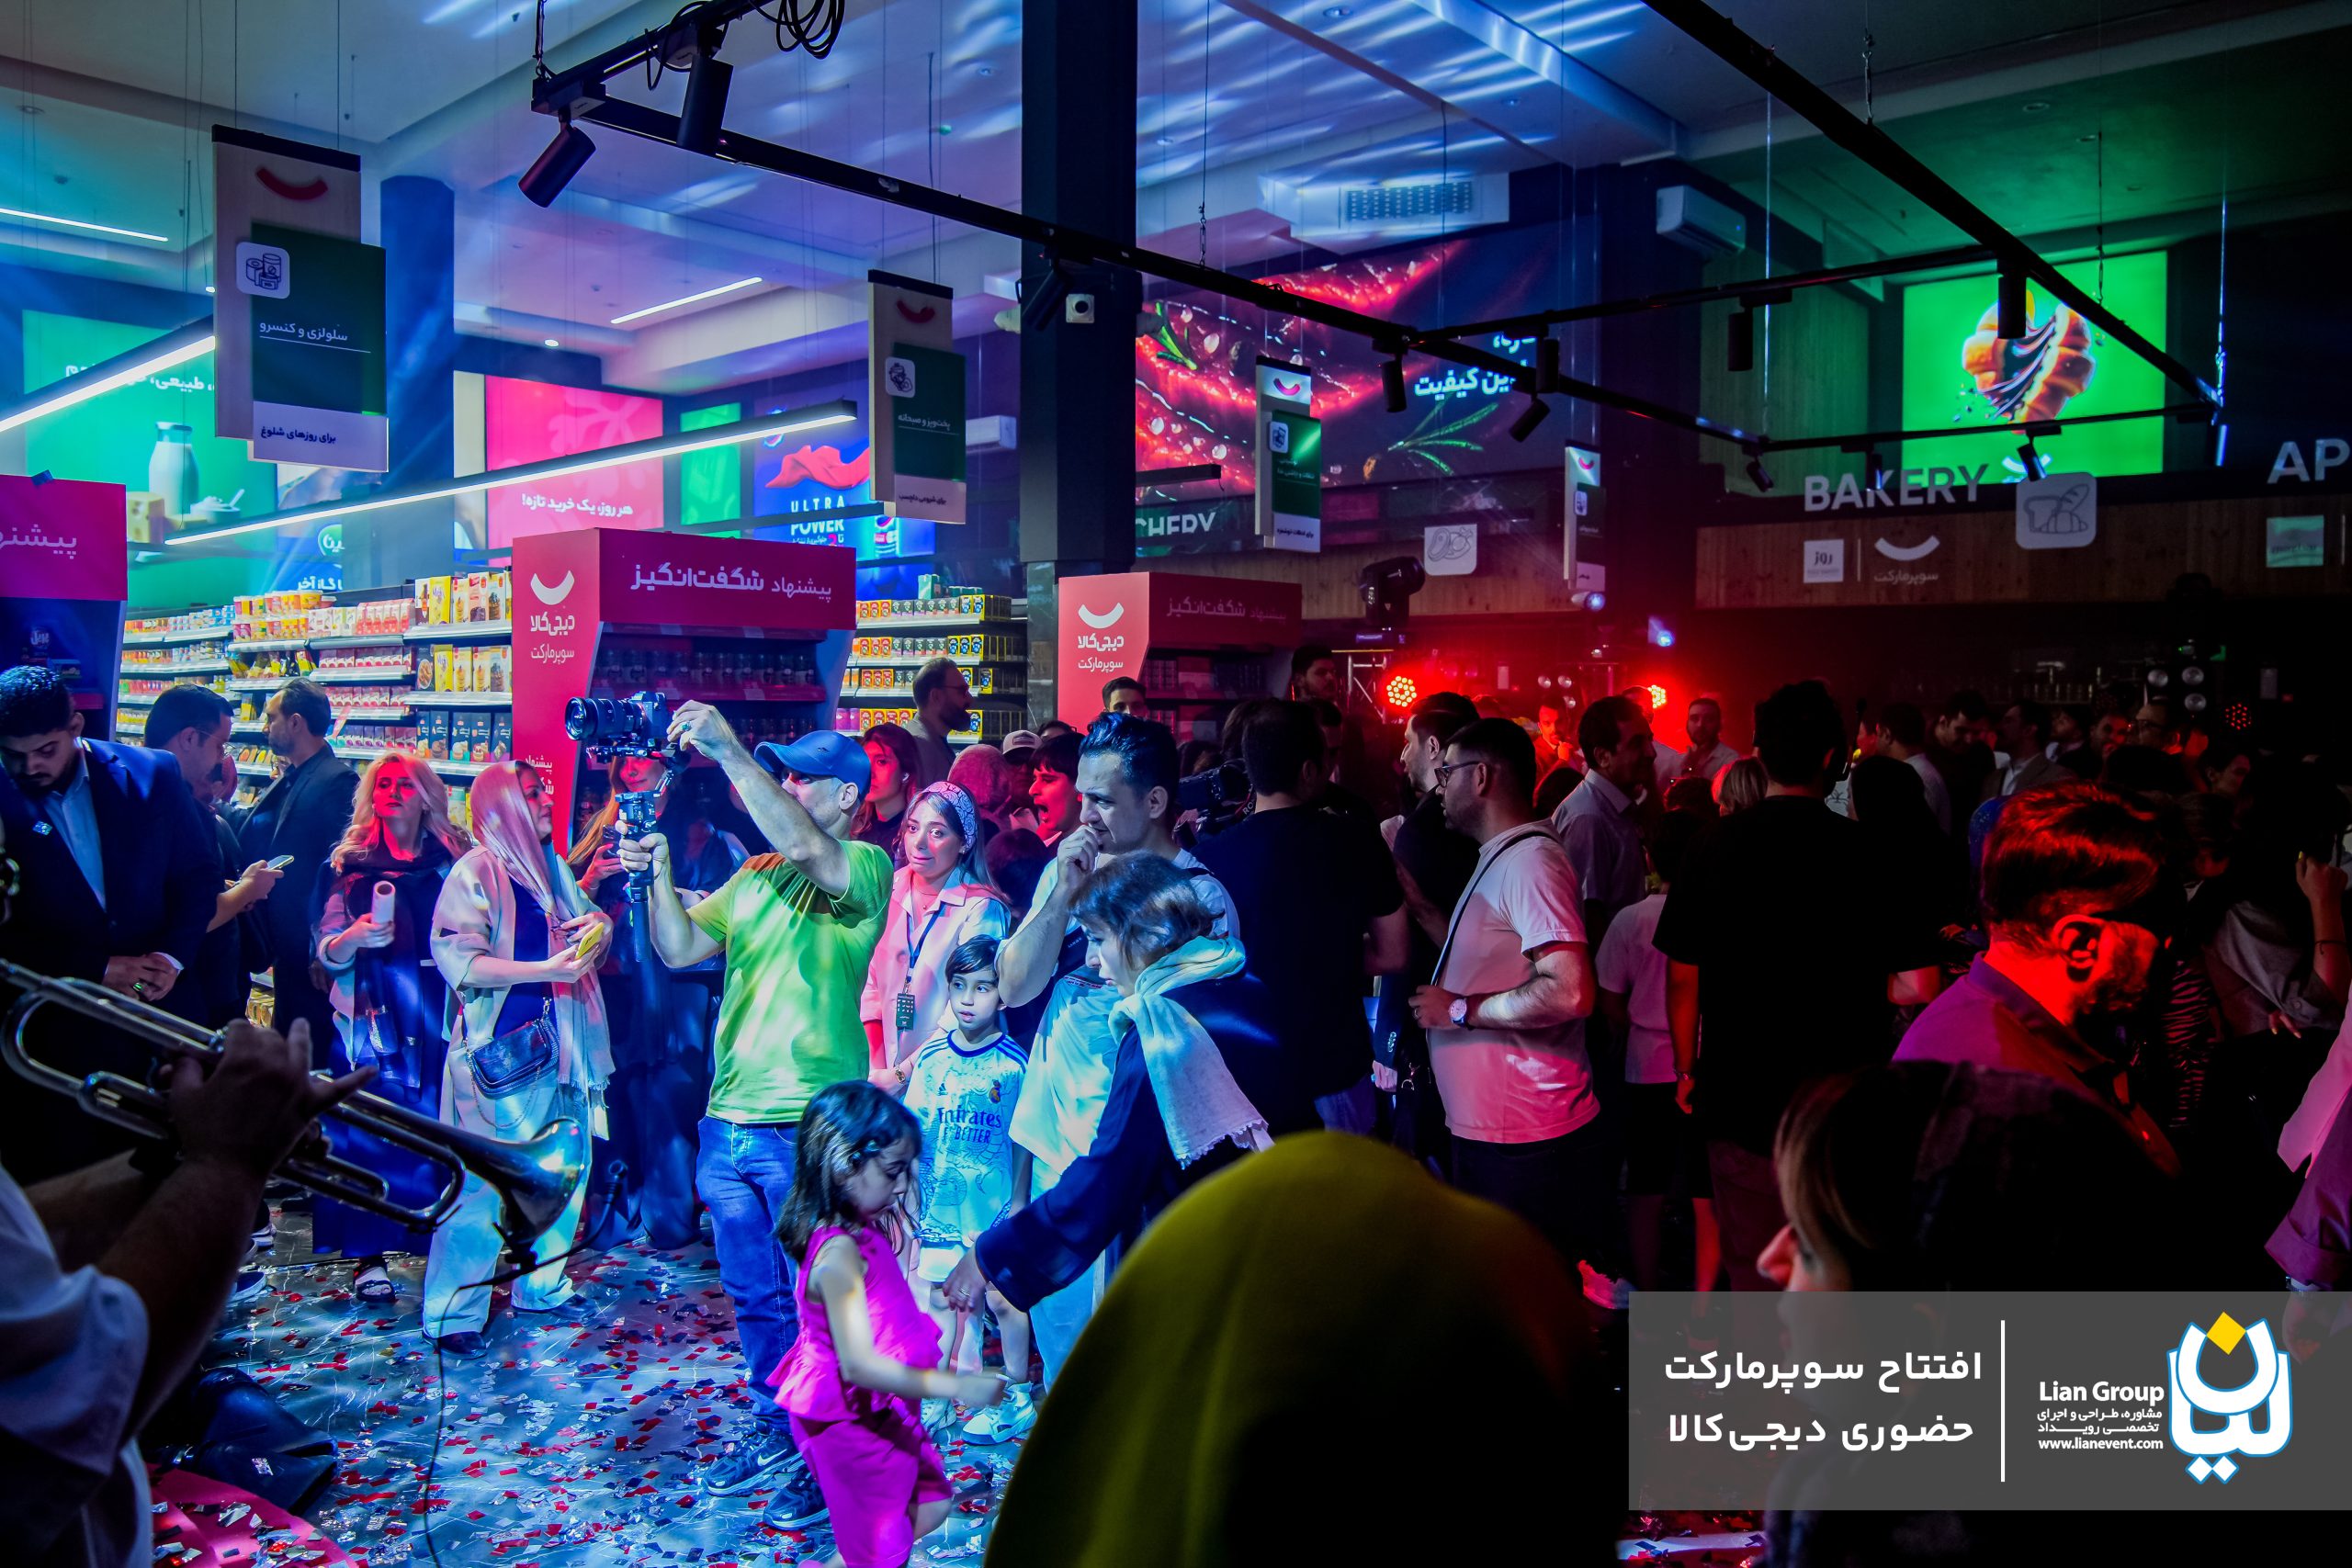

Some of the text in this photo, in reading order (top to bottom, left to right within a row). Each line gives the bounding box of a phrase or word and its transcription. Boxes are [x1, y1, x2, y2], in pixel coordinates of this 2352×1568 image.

[259, 321, 348, 342] سلولزی و کنسرو
[1415, 367, 1478, 401] کیفیت
[260, 425, 336, 445] برای روزهای شلوغ
[1804, 463, 1990, 513] BAKERY
[521, 492, 546, 512] تازه!
[548, 497, 575, 513] خرید
[576, 498, 596, 515] یک
[616, 504, 634, 518] هر
[791, 495, 845, 513] ULTRA
[0, 524, 78, 559] پیشن
[771, 577, 831, 604] پیشنهاد
[530, 643, 575, 665] سوپرمارکت
[1078, 657, 1124, 673] سوپرمارکت
